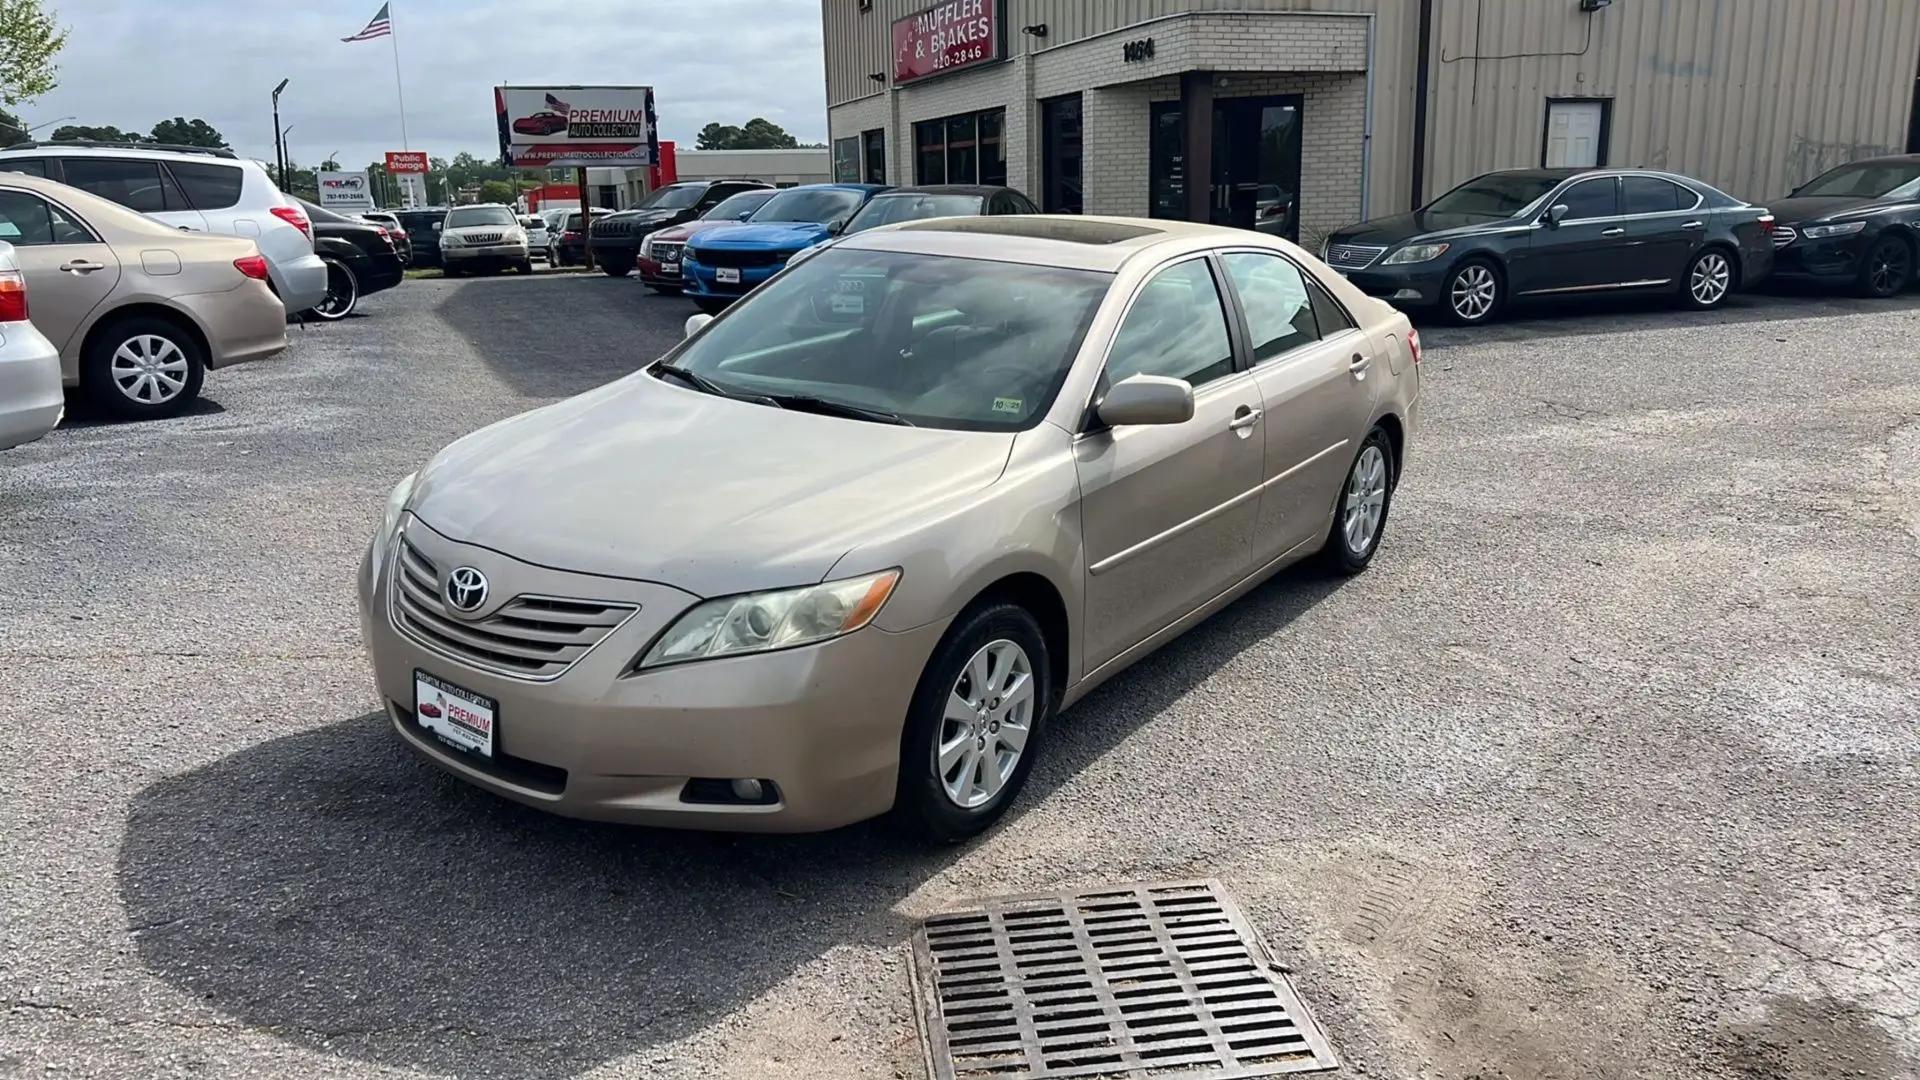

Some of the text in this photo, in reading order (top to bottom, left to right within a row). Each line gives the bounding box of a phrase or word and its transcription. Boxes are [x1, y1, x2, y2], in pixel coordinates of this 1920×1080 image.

[918, 0, 983, 35] MUFFLER
[915, 17, 989, 59] & BRAKES
[933, 45, 982, 70] 420-2846
[569, 109, 643, 123] PREMIUM
[569, 124, 640, 136] AUTO COLLECTION
[390, 162, 425, 171] Storage
[393, 154, 421, 162] Public
[448, 704, 490, 731] PREMIUM
